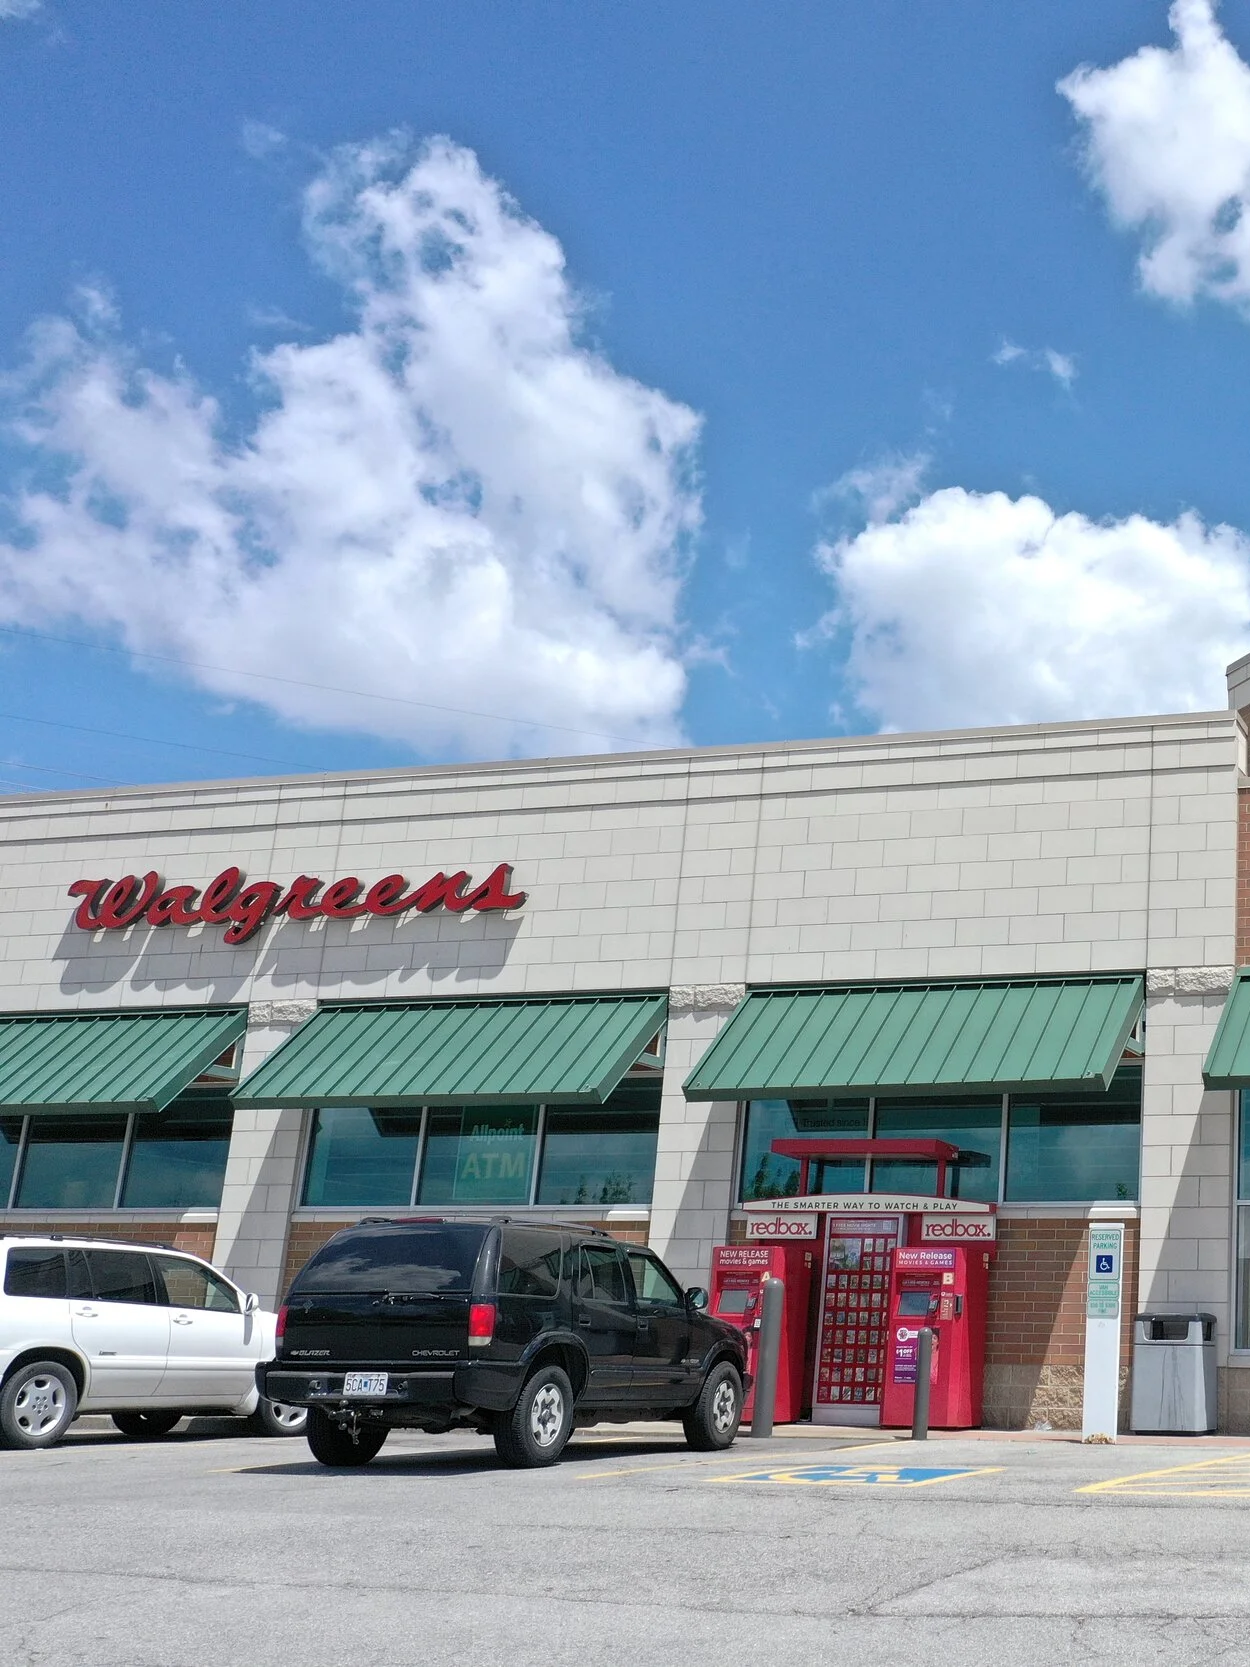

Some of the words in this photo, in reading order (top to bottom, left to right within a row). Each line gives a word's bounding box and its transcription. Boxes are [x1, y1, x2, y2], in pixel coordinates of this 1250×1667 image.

[68, 863, 527, 945] Walgreens
[470, 1123, 525, 1146] Allpoint
[461, 1152, 526, 1180] ATM
[771, 1201, 790, 1209] THE
[793, 1201, 839, 1210] SMARTER
[843, 1202, 865, 1210] WAY
[868, 1202, 881, 1210] TO
[884, 1202, 919, 1210] WATCH
[922, 1202, 929, 1210] &
[750, 1217, 813, 1236] redbox.
[925, 1216, 991, 1237] redbox.
[720, 1250, 737, 1258] NEW
[738, 1250, 769, 1258] RELEASE
[899, 1252, 918, 1260] New
[920, 1252, 953, 1260] Release
[747, 1258, 769, 1267] games
[761, 1271, 771, 1282] A
[943, 1272, 954, 1285] B
[411, 1349, 460, 1357] CHEVROLET
